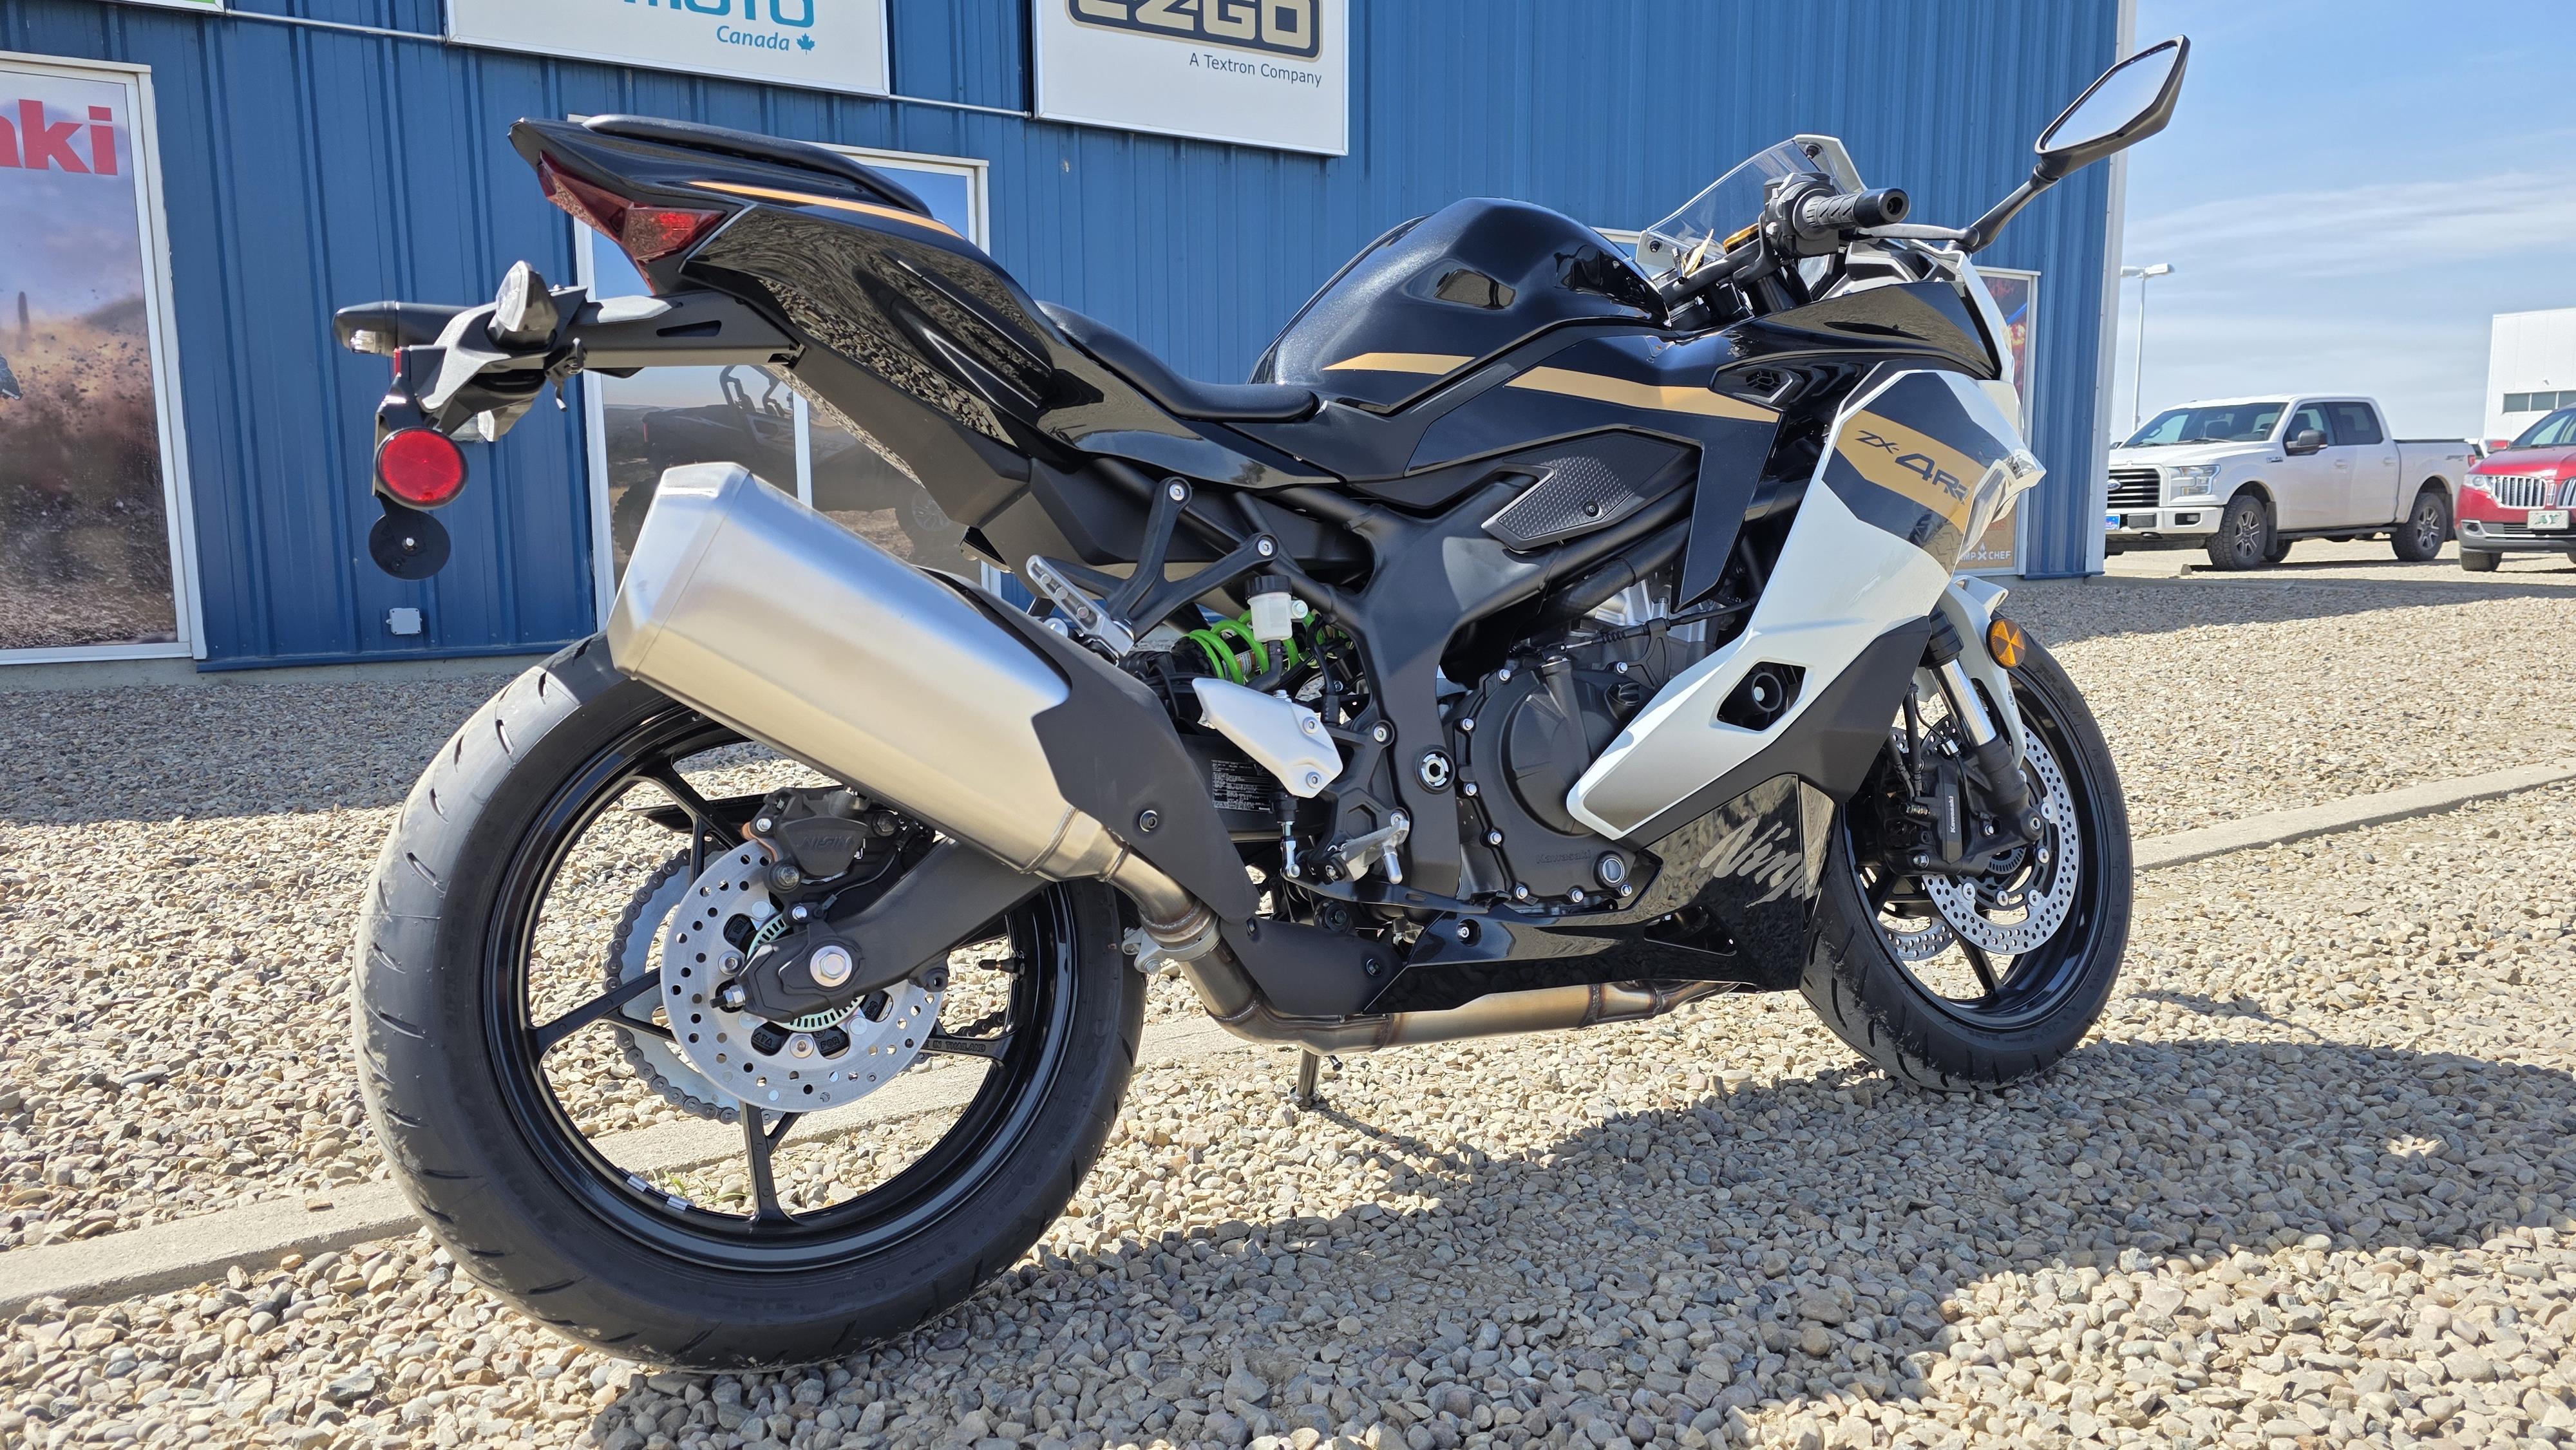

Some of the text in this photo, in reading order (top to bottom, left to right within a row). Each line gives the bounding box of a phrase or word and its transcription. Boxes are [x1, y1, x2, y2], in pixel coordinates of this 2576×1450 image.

[715, 25, 790, 52] Canada
[1189, 52, 1322, 88] A Textron Company
[1988, 550, 2012, 560] CHEF
[1536, 848, 1592, 865] Kawasaki
[933, 1040, 942, 1049] IN
[945, 1040, 986, 1053] THAILAND
